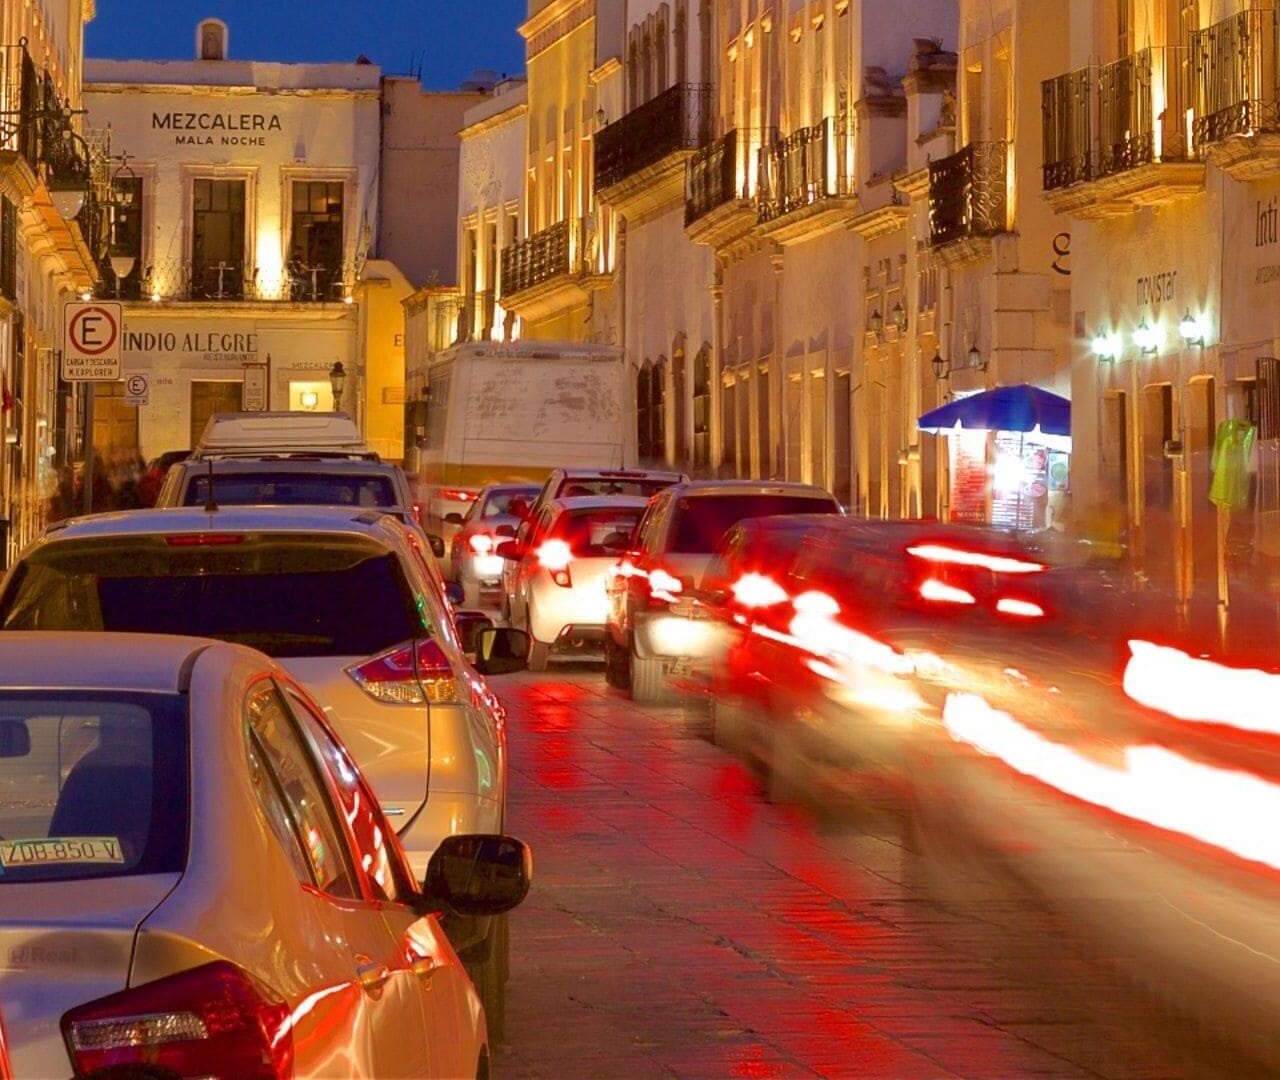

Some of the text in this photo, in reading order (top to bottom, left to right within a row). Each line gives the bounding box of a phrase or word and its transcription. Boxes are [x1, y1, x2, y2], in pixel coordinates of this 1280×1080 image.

[152, 113, 282, 131] MEZCALERA
[175, 136, 266, 146] MALA NOCHE
[1255, 195, 1277, 247] Inti
[1137, 270, 1177, 307] movistar
[82, 317, 102, 345] E
[123, 333, 258, 352] INDIO ALEGRE
[7, 841, 120, 863] ZDB-850-V
